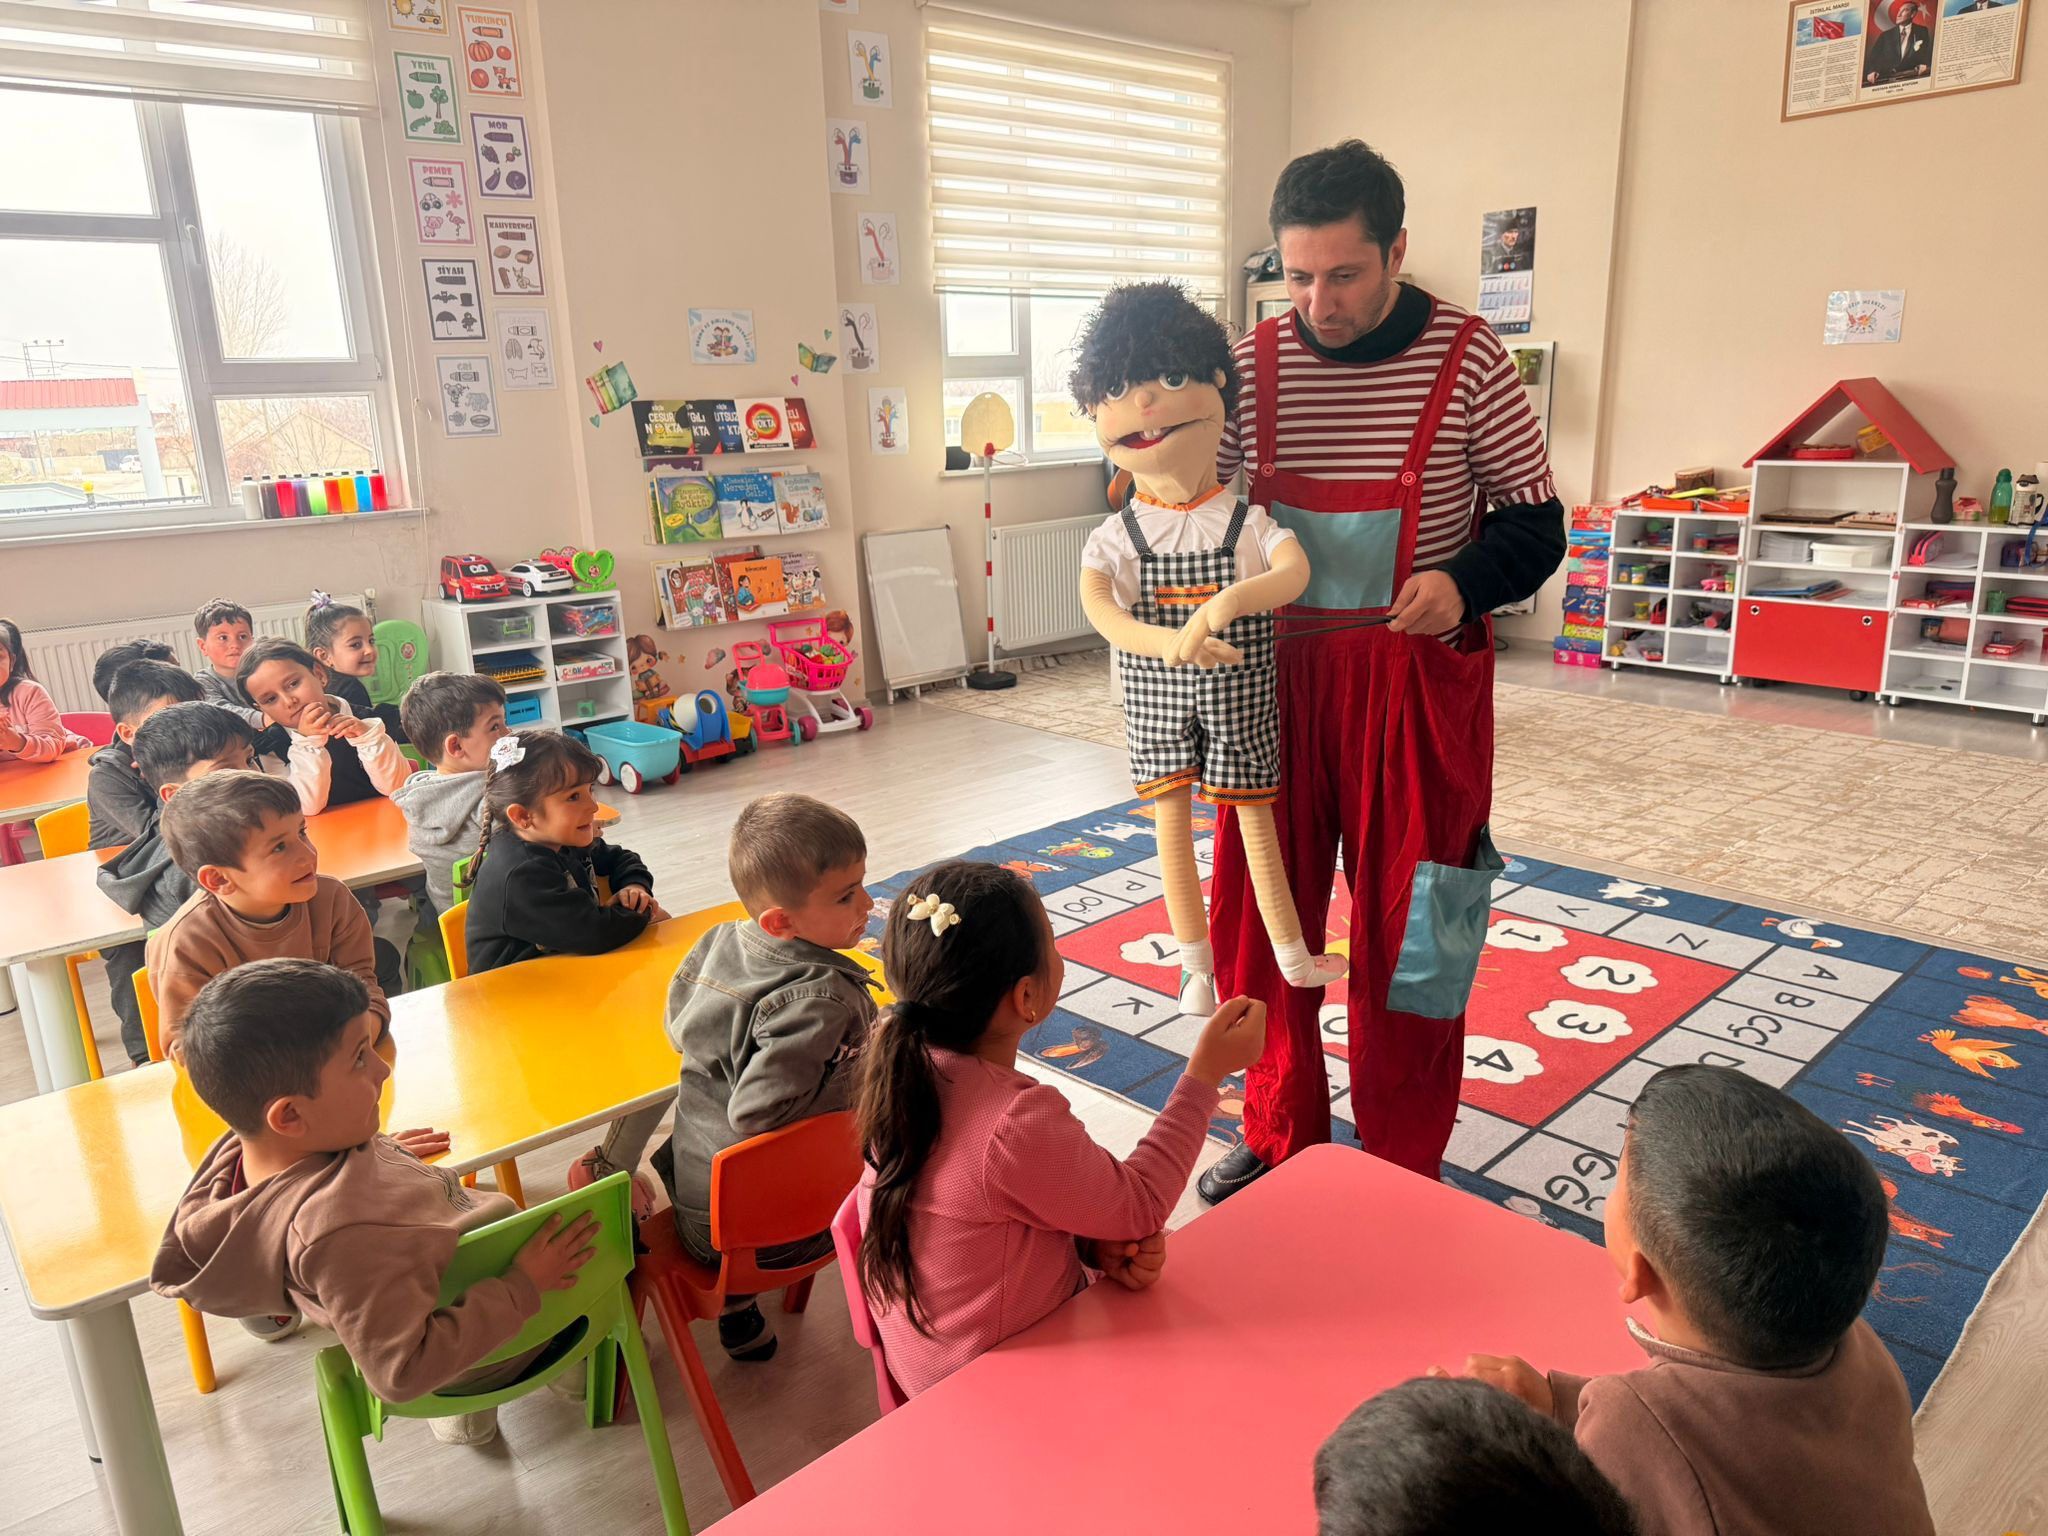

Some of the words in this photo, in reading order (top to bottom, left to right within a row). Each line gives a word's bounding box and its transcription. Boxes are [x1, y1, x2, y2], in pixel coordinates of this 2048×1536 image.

[411, 60, 436, 71] YEŞİL
[488, 121, 508, 130] MOR
[422, 165, 452, 175] PEMBE
[648, 412, 675, 422] CESUR
[714, 412, 739, 422] UTSUZ
[692, 426, 711, 436] KTA
[693, 461, 700, 471] 7
[1126, 880, 1146, 891] P
[1557, 905, 1590, 917] Y
[1500, 928, 1541, 942] 1
[1666, 933, 1709, 950] Z
[1150, 941, 1180, 960] 7
[1586, 966, 1635, 985] 2
[1802, 964, 1839, 980] A
[1112, 997, 1154, 1015] K
[1775, 992, 1815, 1008] B
[1557, 1013, 1607, 1035] 3
[1727, 1015, 1782, 1046] CÇ
[1466, 1049, 1514, 1072] 4
[1698, 1051, 1746, 1068] D
